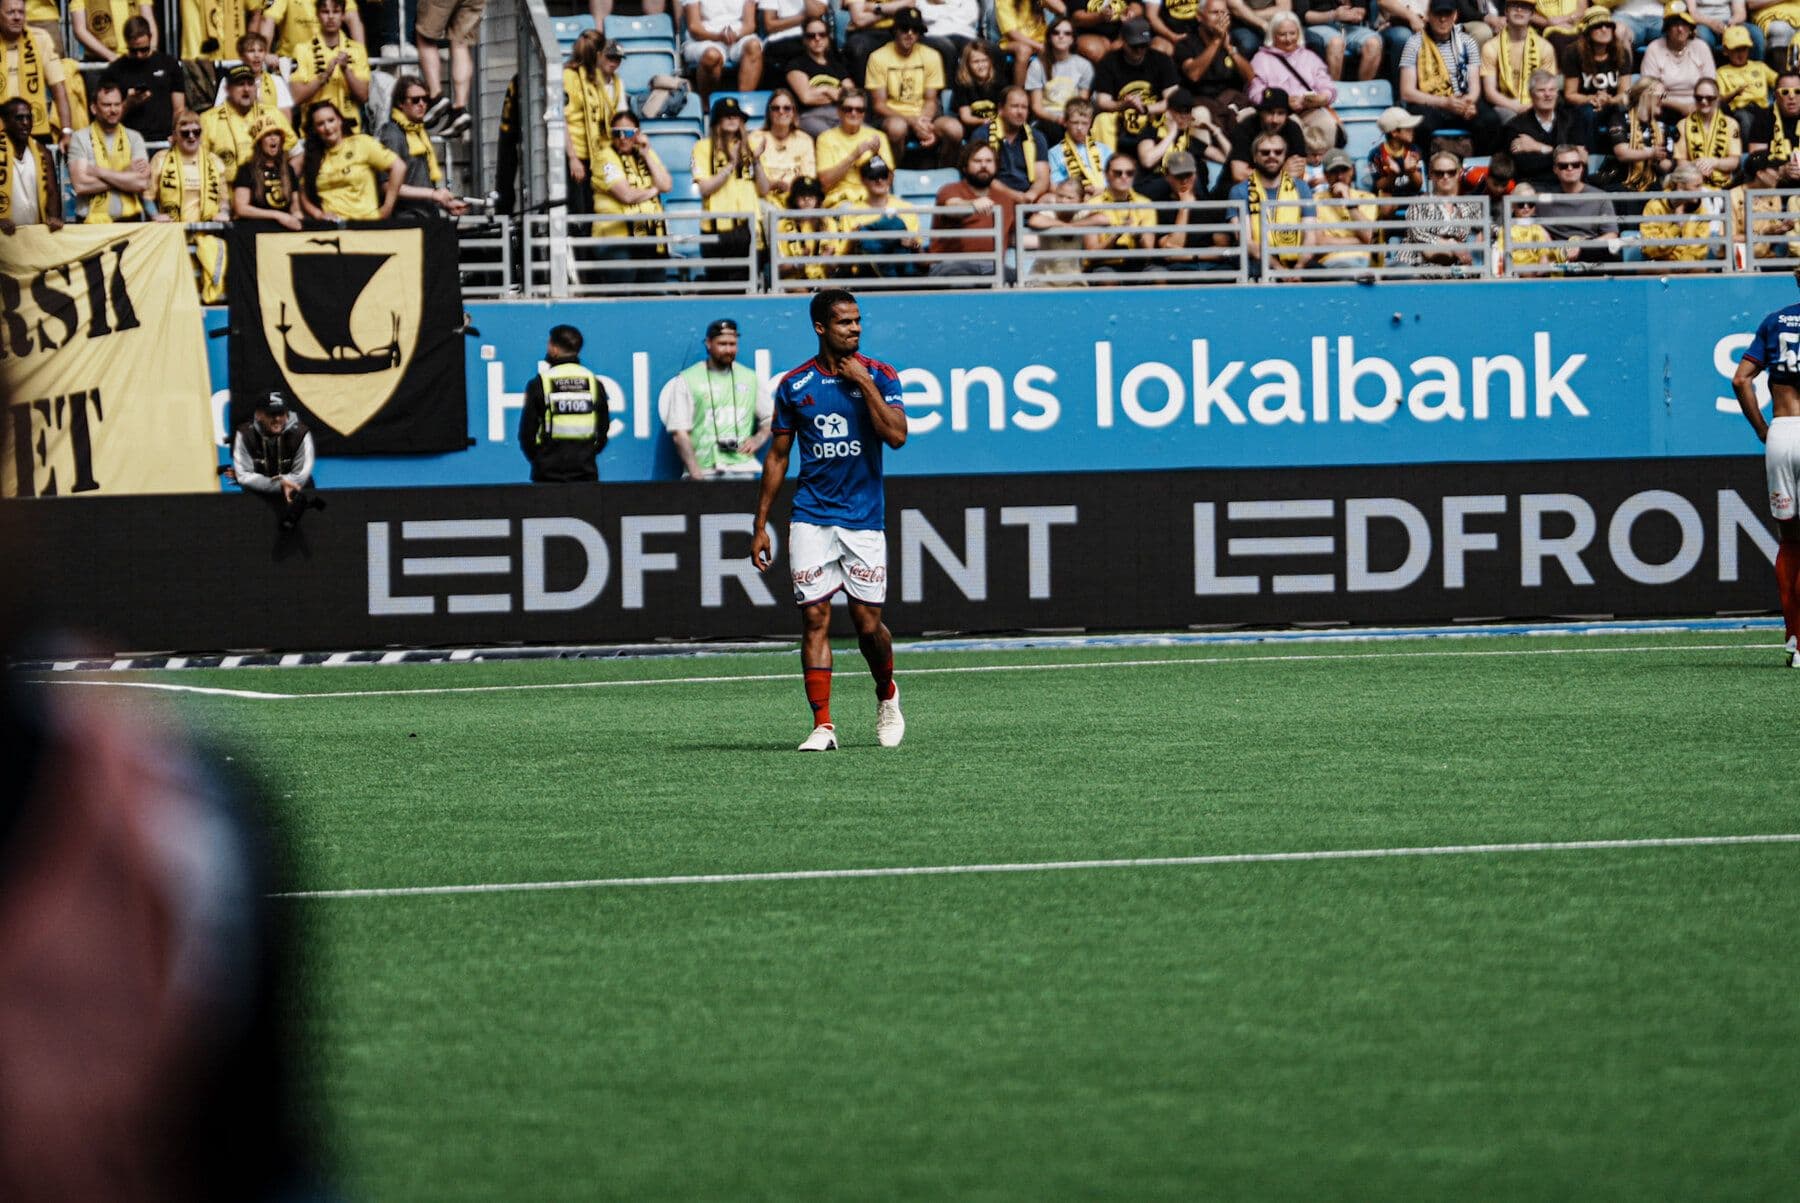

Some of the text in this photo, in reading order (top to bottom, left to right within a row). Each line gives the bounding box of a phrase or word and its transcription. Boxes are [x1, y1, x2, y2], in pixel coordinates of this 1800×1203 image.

[1581, 70, 1619, 88] YOU
[1096, 331, 1589, 427] lokalbank
[812, 440, 862, 459] OBOS
[366, 504, 1078, 617] LEDFRNT
